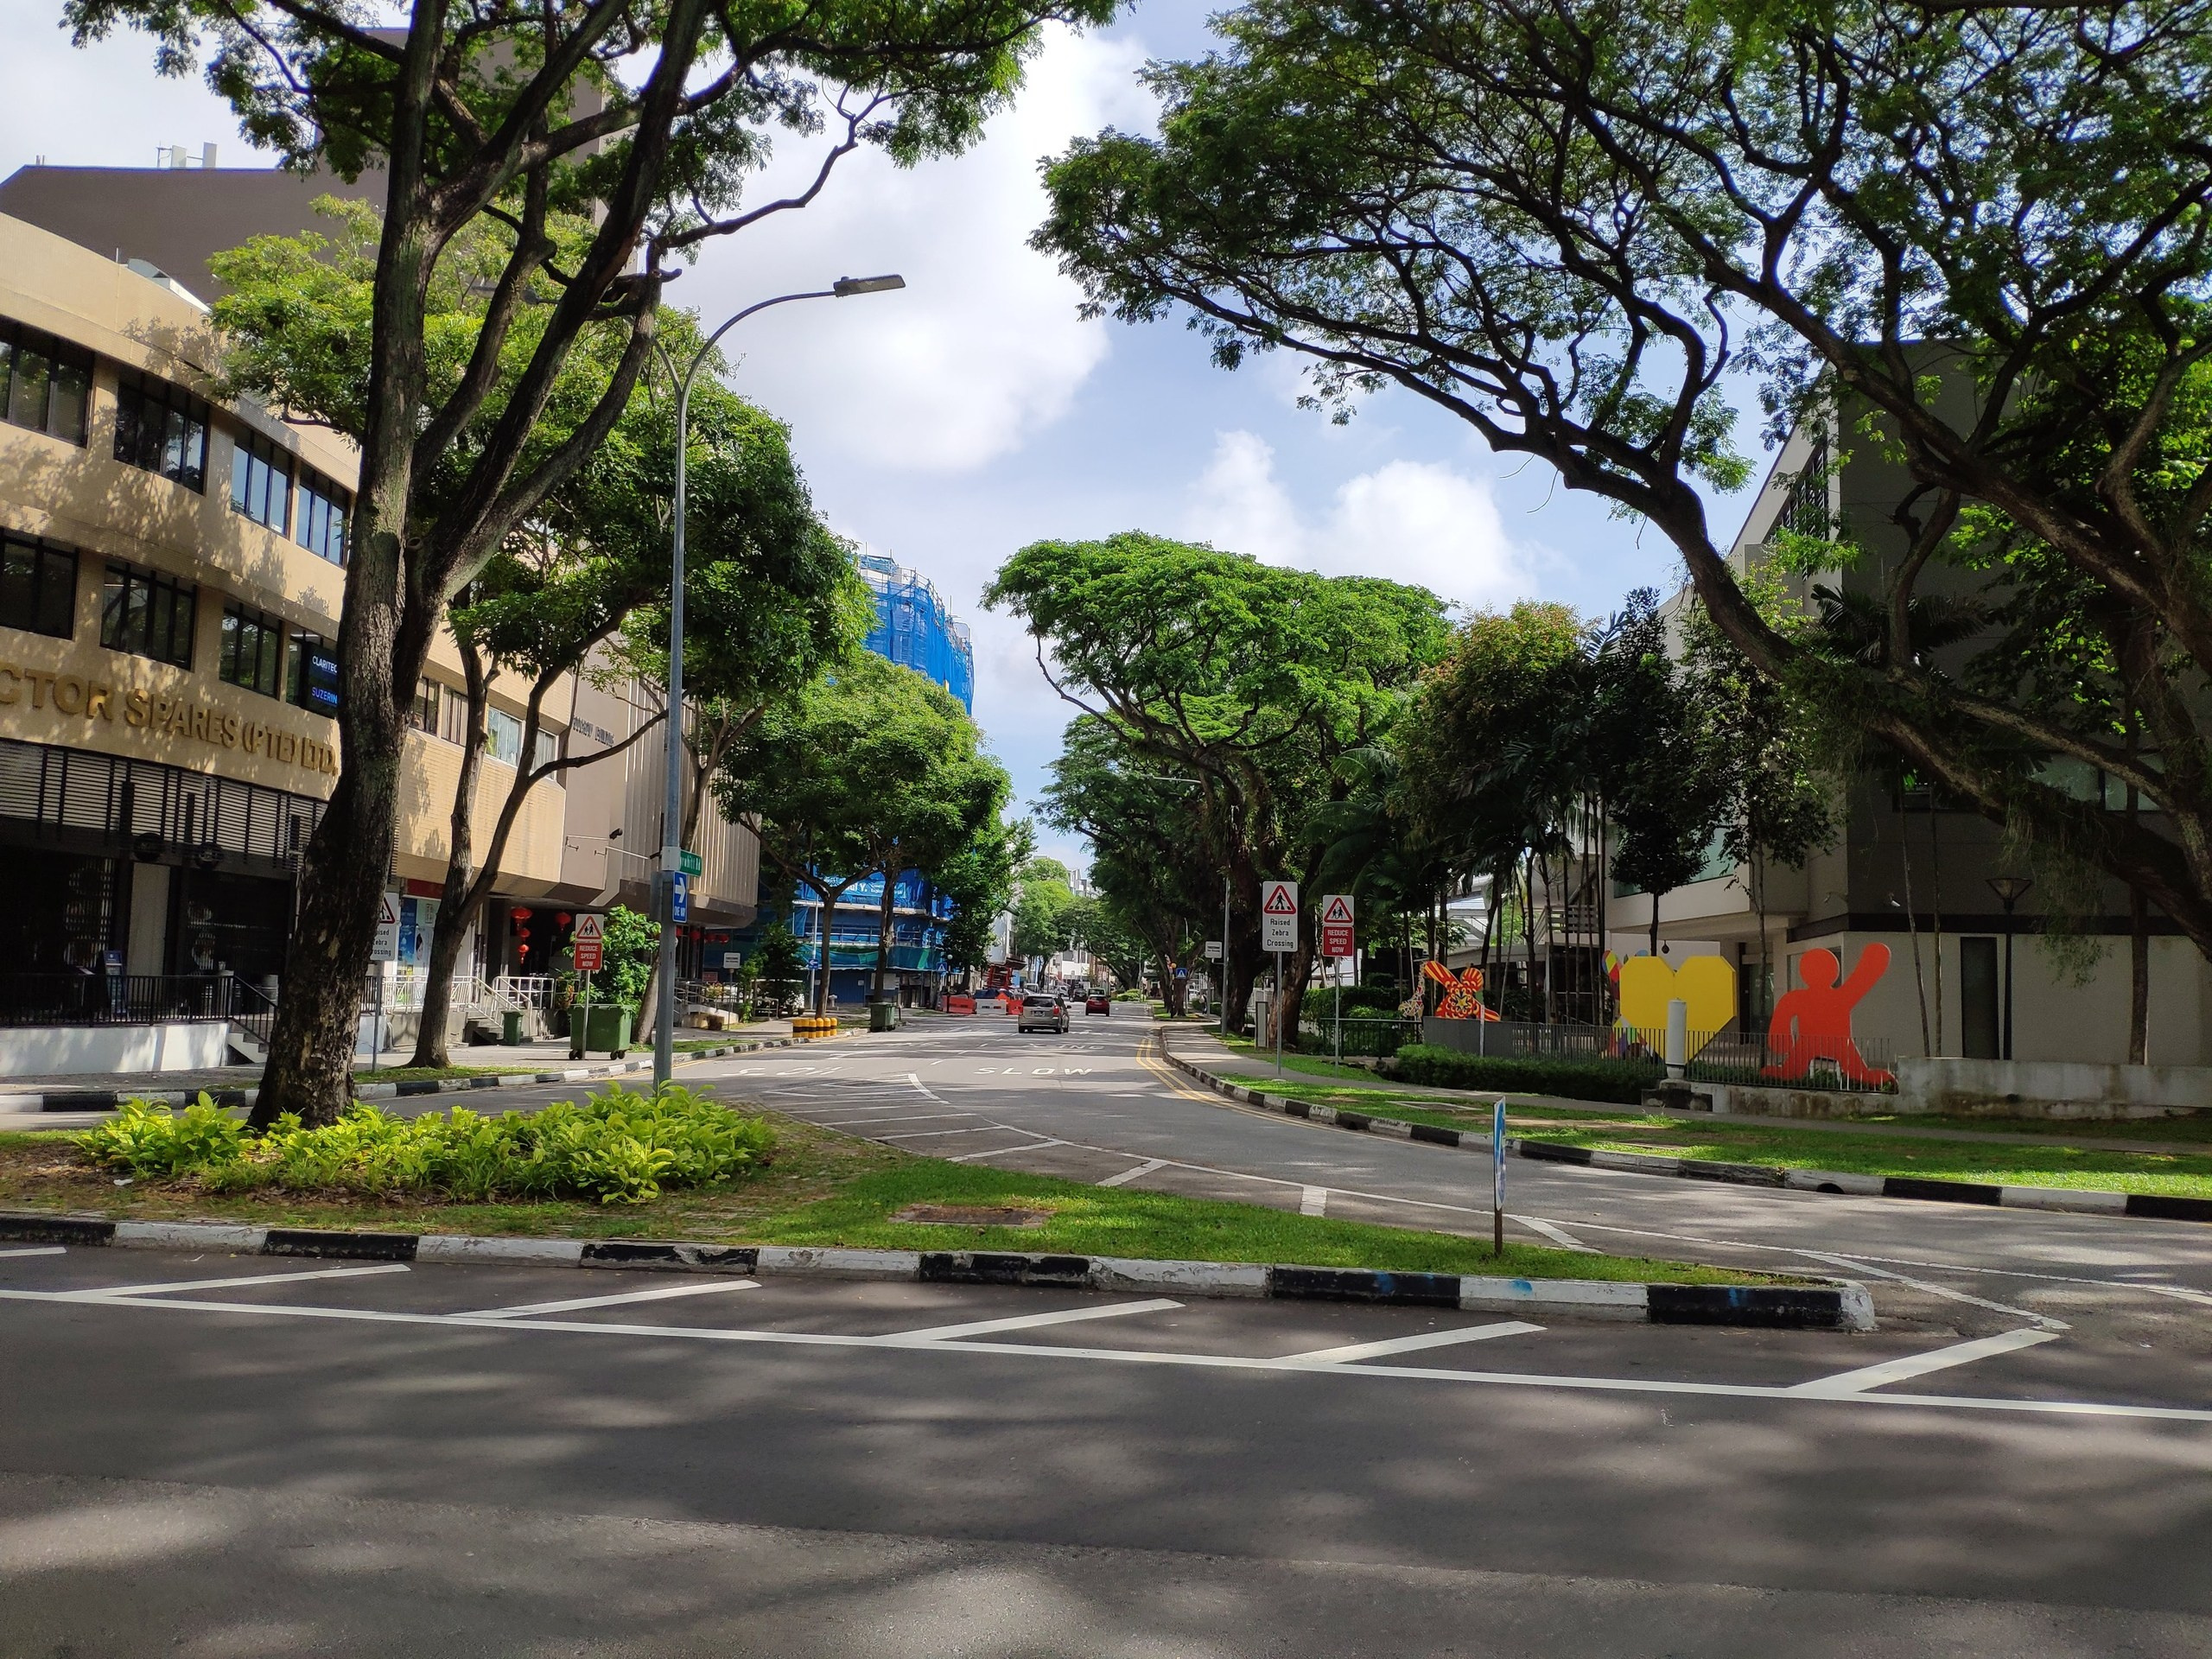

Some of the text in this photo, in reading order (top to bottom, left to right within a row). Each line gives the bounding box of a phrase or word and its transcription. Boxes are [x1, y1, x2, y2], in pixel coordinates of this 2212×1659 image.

[124, 689, 238, 749] SPARES
[243, 721, 297, 764] (PTE)
[301, 736, 339, 777] LTD.
[1267, 939, 1294, 949] Crossing
[974, 1066, 1093, 1076] SLOW
